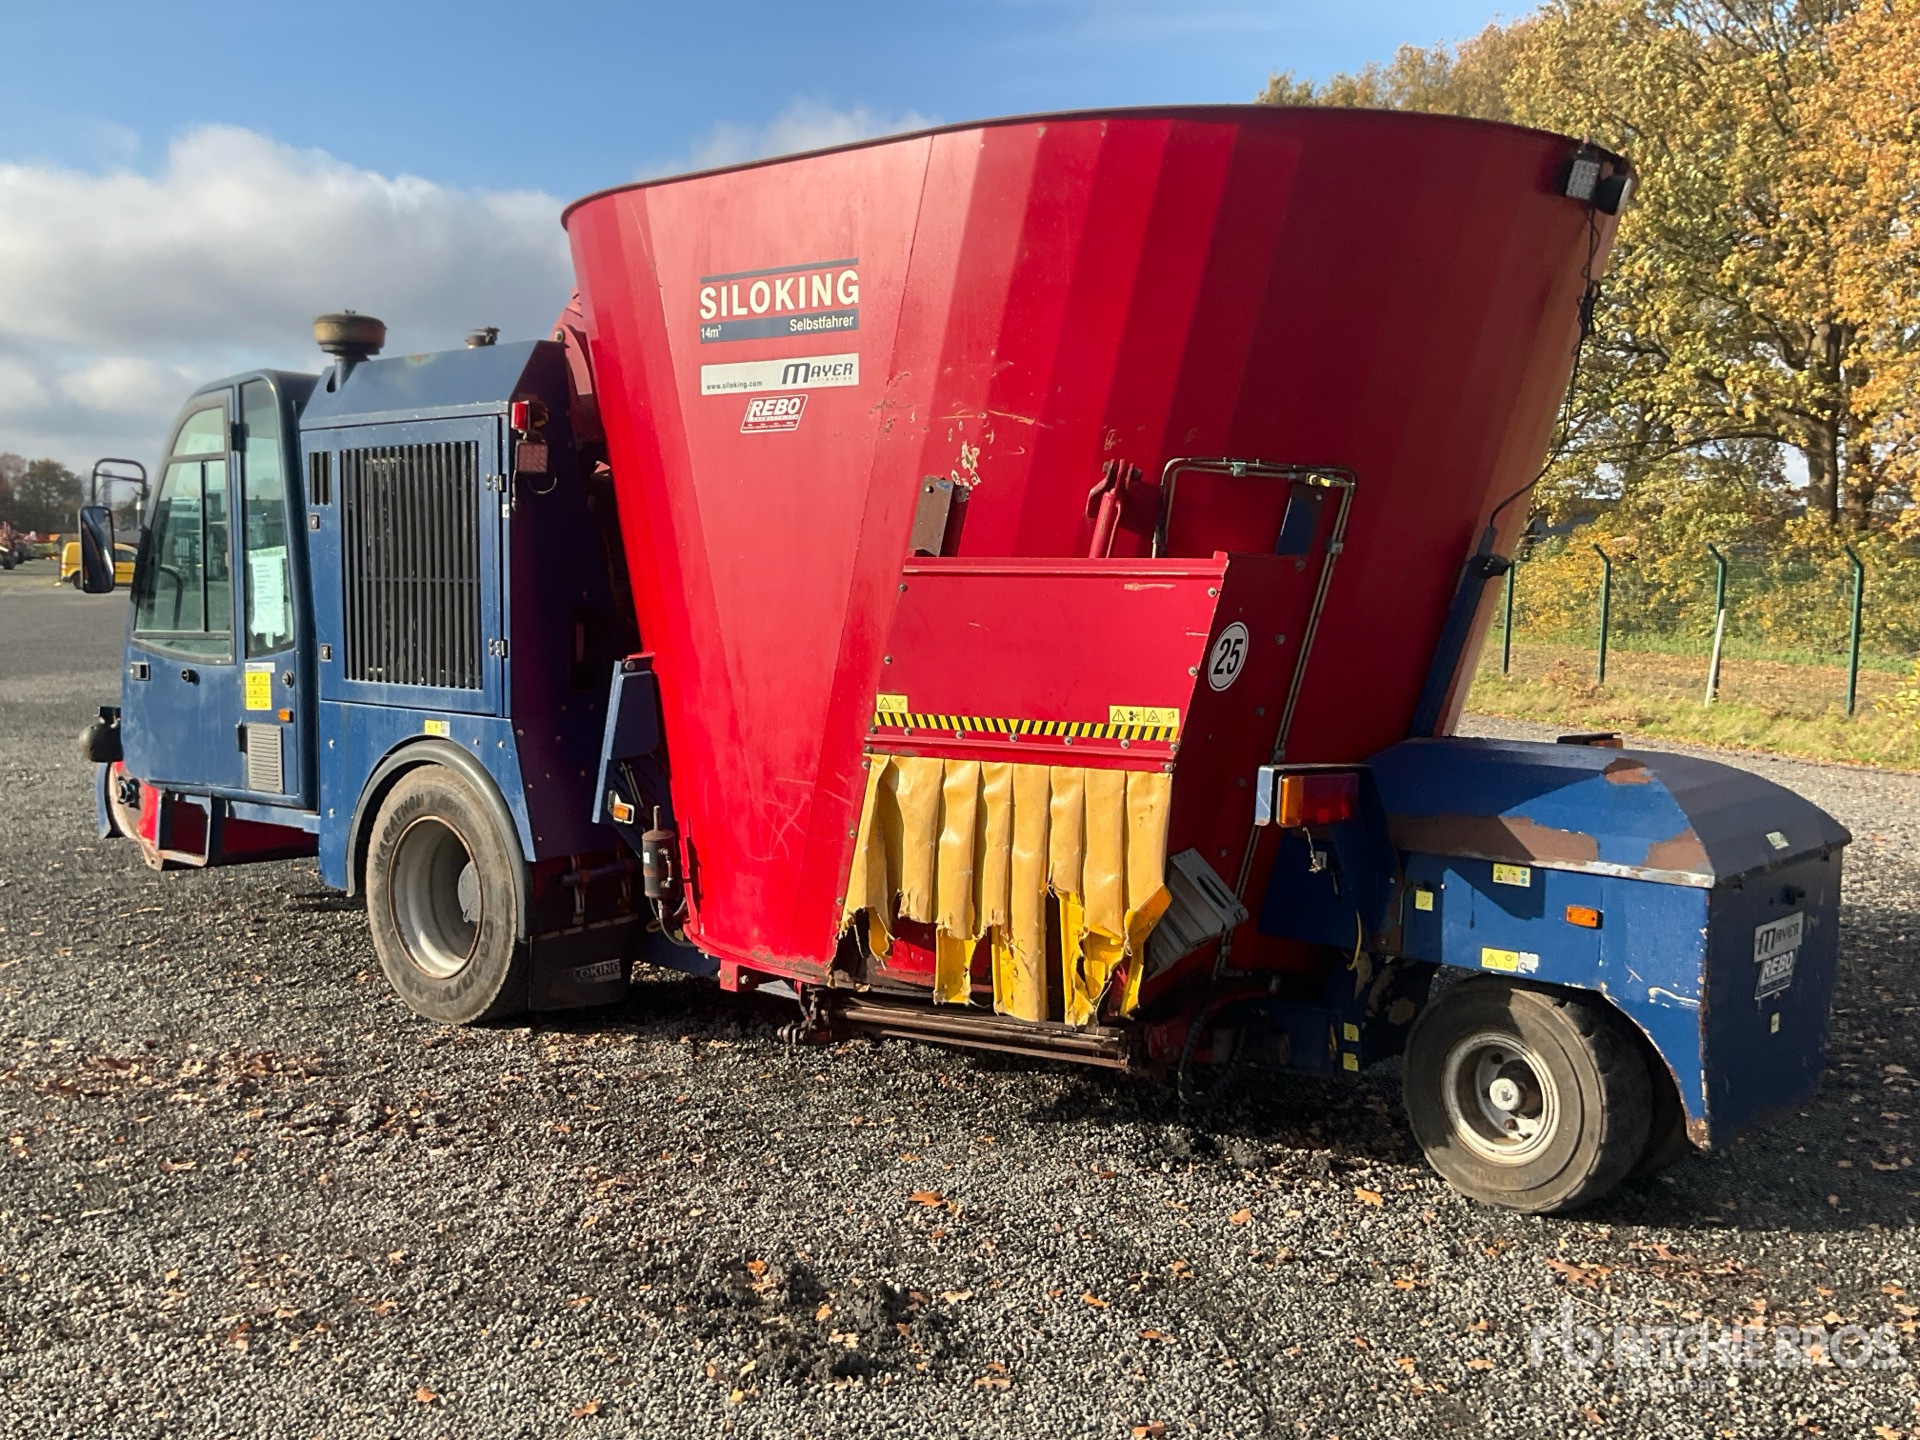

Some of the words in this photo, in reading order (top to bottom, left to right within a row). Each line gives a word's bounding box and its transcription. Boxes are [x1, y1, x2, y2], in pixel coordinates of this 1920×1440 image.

[700, 270, 859, 320] SILOKING
[790, 316, 854, 331] Selbstfahrer
[706, 380, 763, 390] www.siloking.com
[782, 363, 854, 384] MAYER
[750, 398, 801, 417] REBO
[1213, 638, 1244, 674] 25
